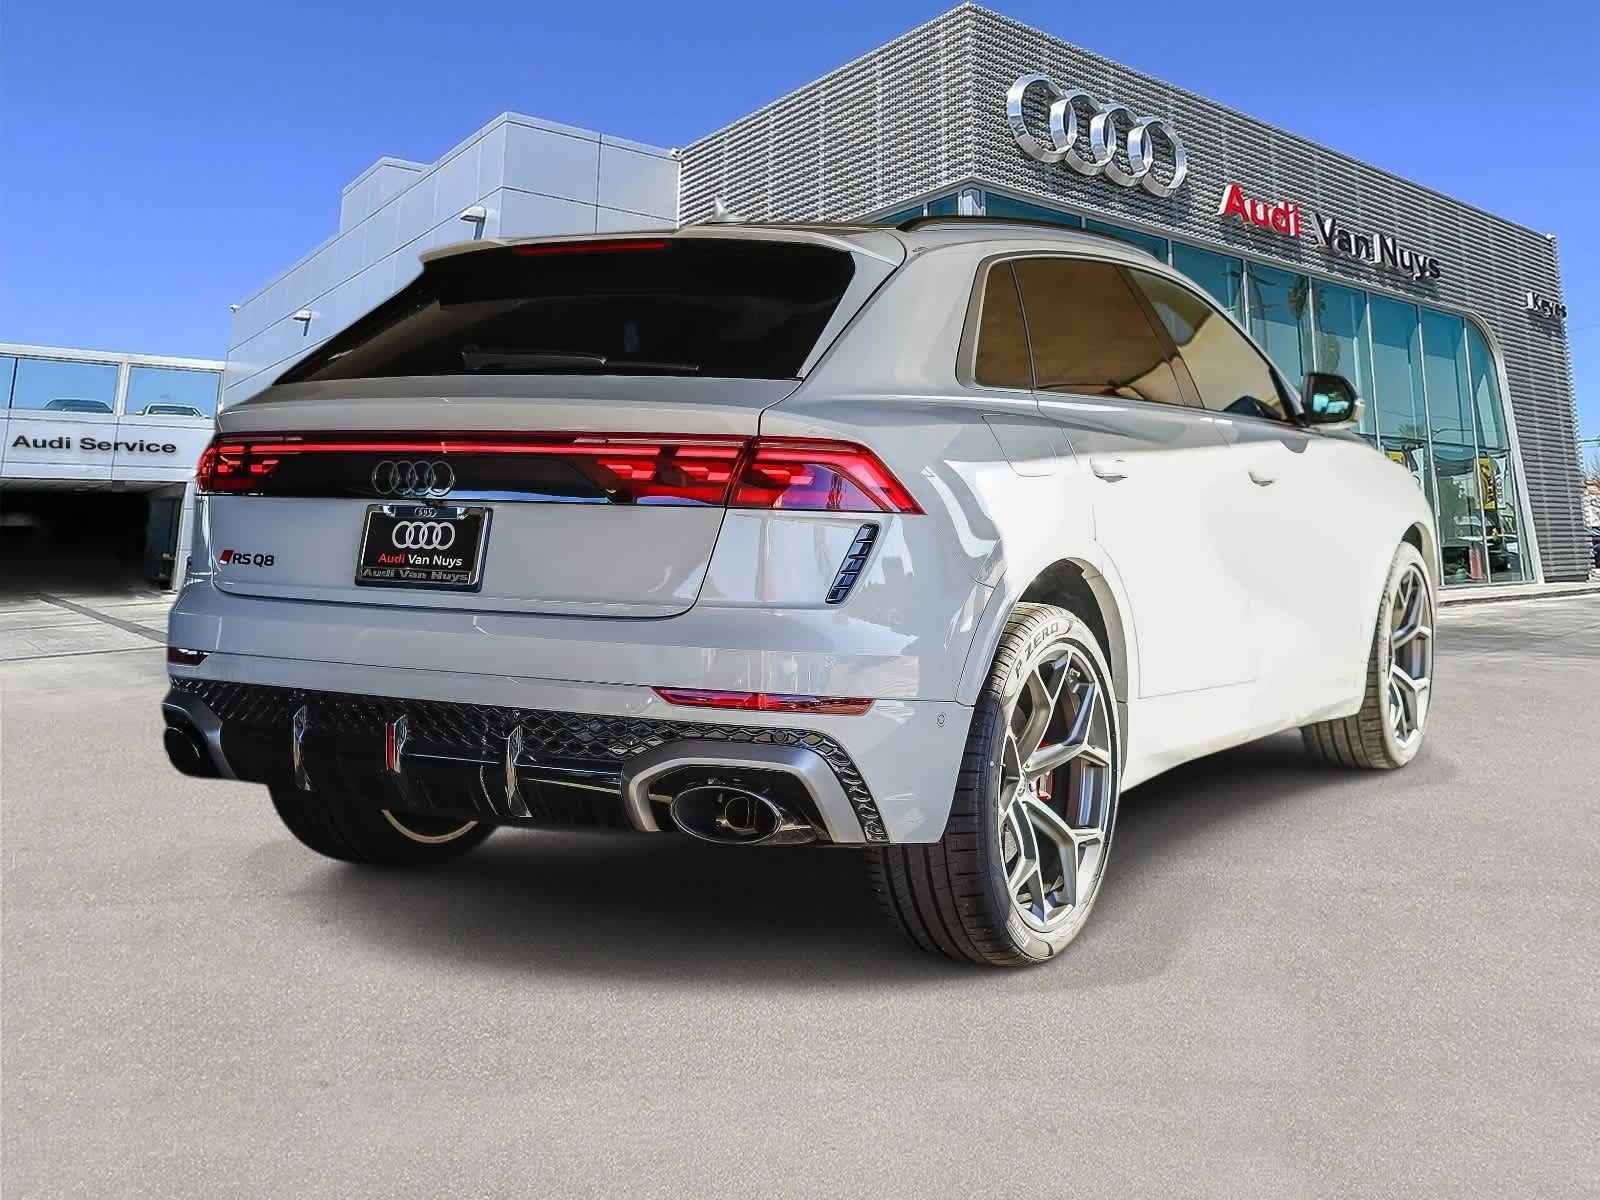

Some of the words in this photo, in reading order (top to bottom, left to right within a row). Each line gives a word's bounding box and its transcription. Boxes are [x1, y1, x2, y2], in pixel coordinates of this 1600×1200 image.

[1219, 182, 1302, 237] Audi
[1311, 211, 1371, 259] Van
[1373, 232, 1442, 281] Nuys
[1526, 291, 1567, 319] Keyes
[12, 435, 71, 450] Audi
[79, 437, 177, 454] Service
[232, 553, 252, 566] RS
[253, 554, 275, 568] Q8
[378, 552, 406, 564] Audi
[408, 554, 430, 565] Van
[432, 555, 463, 568] Nuys
[362, 568, 395, 578] Audi
[400, 570, 427, 579] Van
[431, 571, 469, 582] Nuys
[1024, 621, 1059, 662] ZERO
